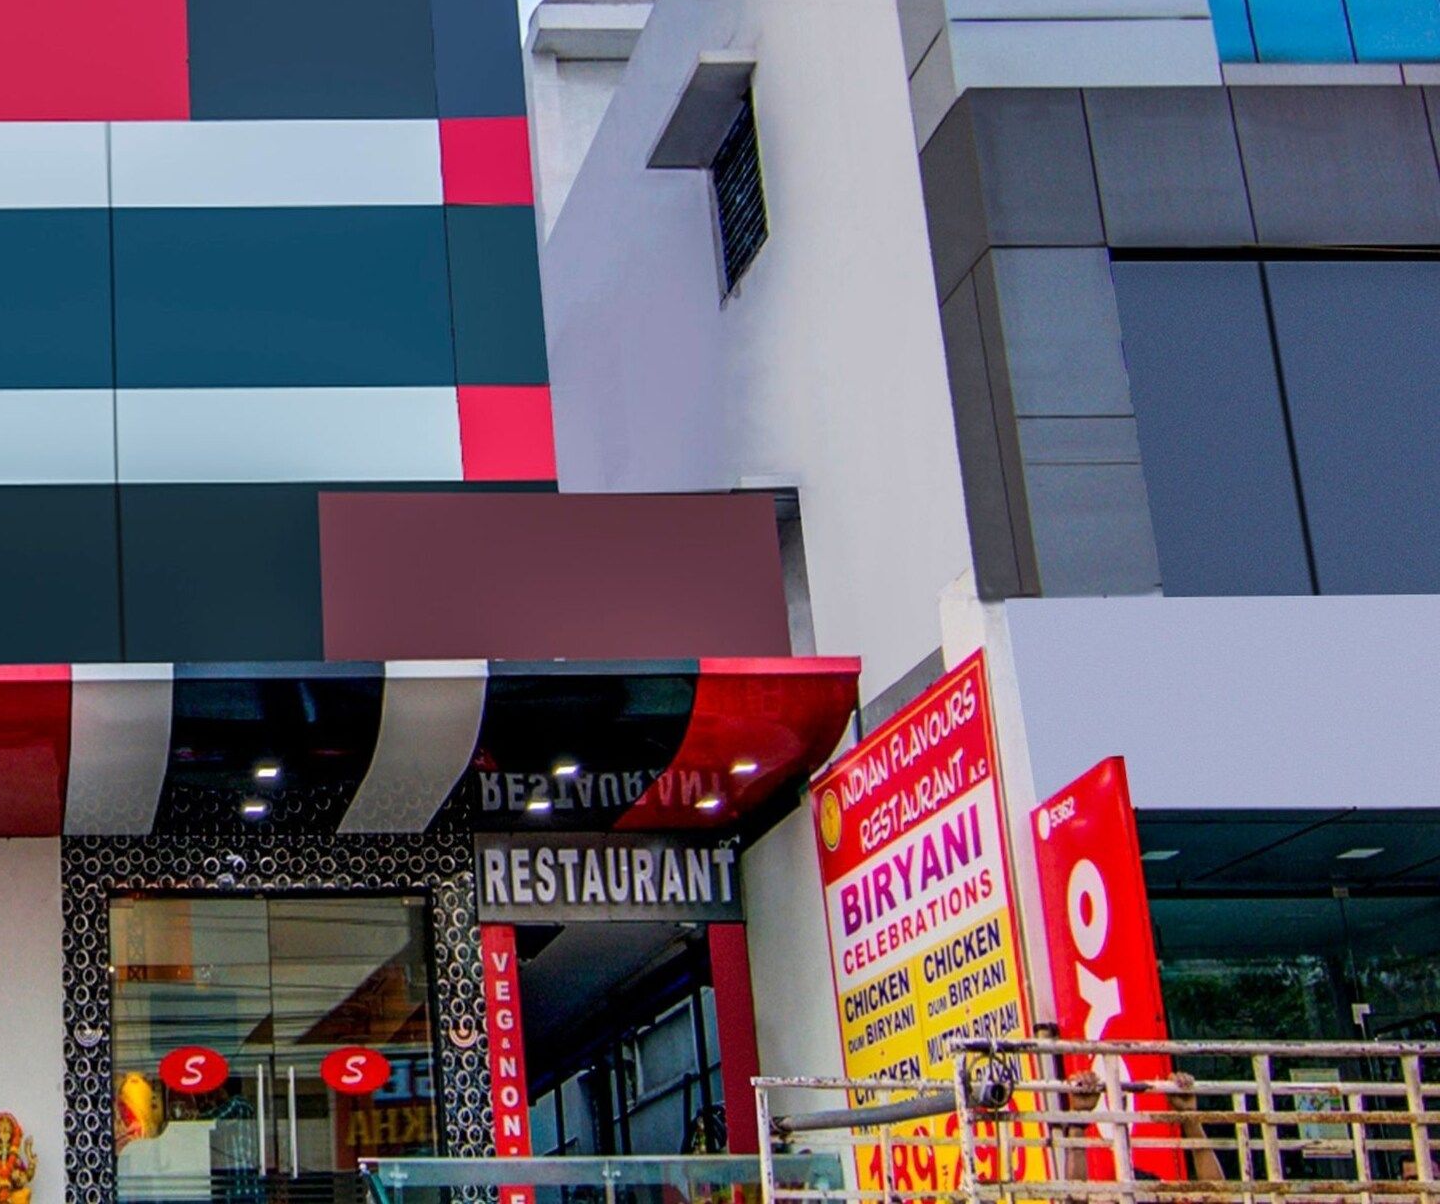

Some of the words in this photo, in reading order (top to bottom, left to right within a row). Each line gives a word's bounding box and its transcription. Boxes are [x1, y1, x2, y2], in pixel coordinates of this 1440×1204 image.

[840, 746, 889, 811] INDIAN
[890, 679, 976, 773] FLAVOURS
[860, 748, 964, 854] RESTAURANT
[484, 847, 735, 902] RESTAURANT
[841, 803, 982, 937] BIRYANI
[843, 869, 993, 975] CELEBRATIONS
[923, 918, 1001, 983] CHICKEN
[491, 952, 514, 1030] VEG
[844, 967, 910, 1023] CHICKEN
[928, 997, 947, 1017] DUM
[948, 959, 1007, 1007] BIRYANI
[972, 1000, 1020, 1041] BIRYANI
[1067, 858, 1135, 1141] OYO
[848, 1035, 866, 1054] DUM
[866, 1004, 916, 1045] BIRYANI
[855, 1056, 921, 1106] CHCKEN
